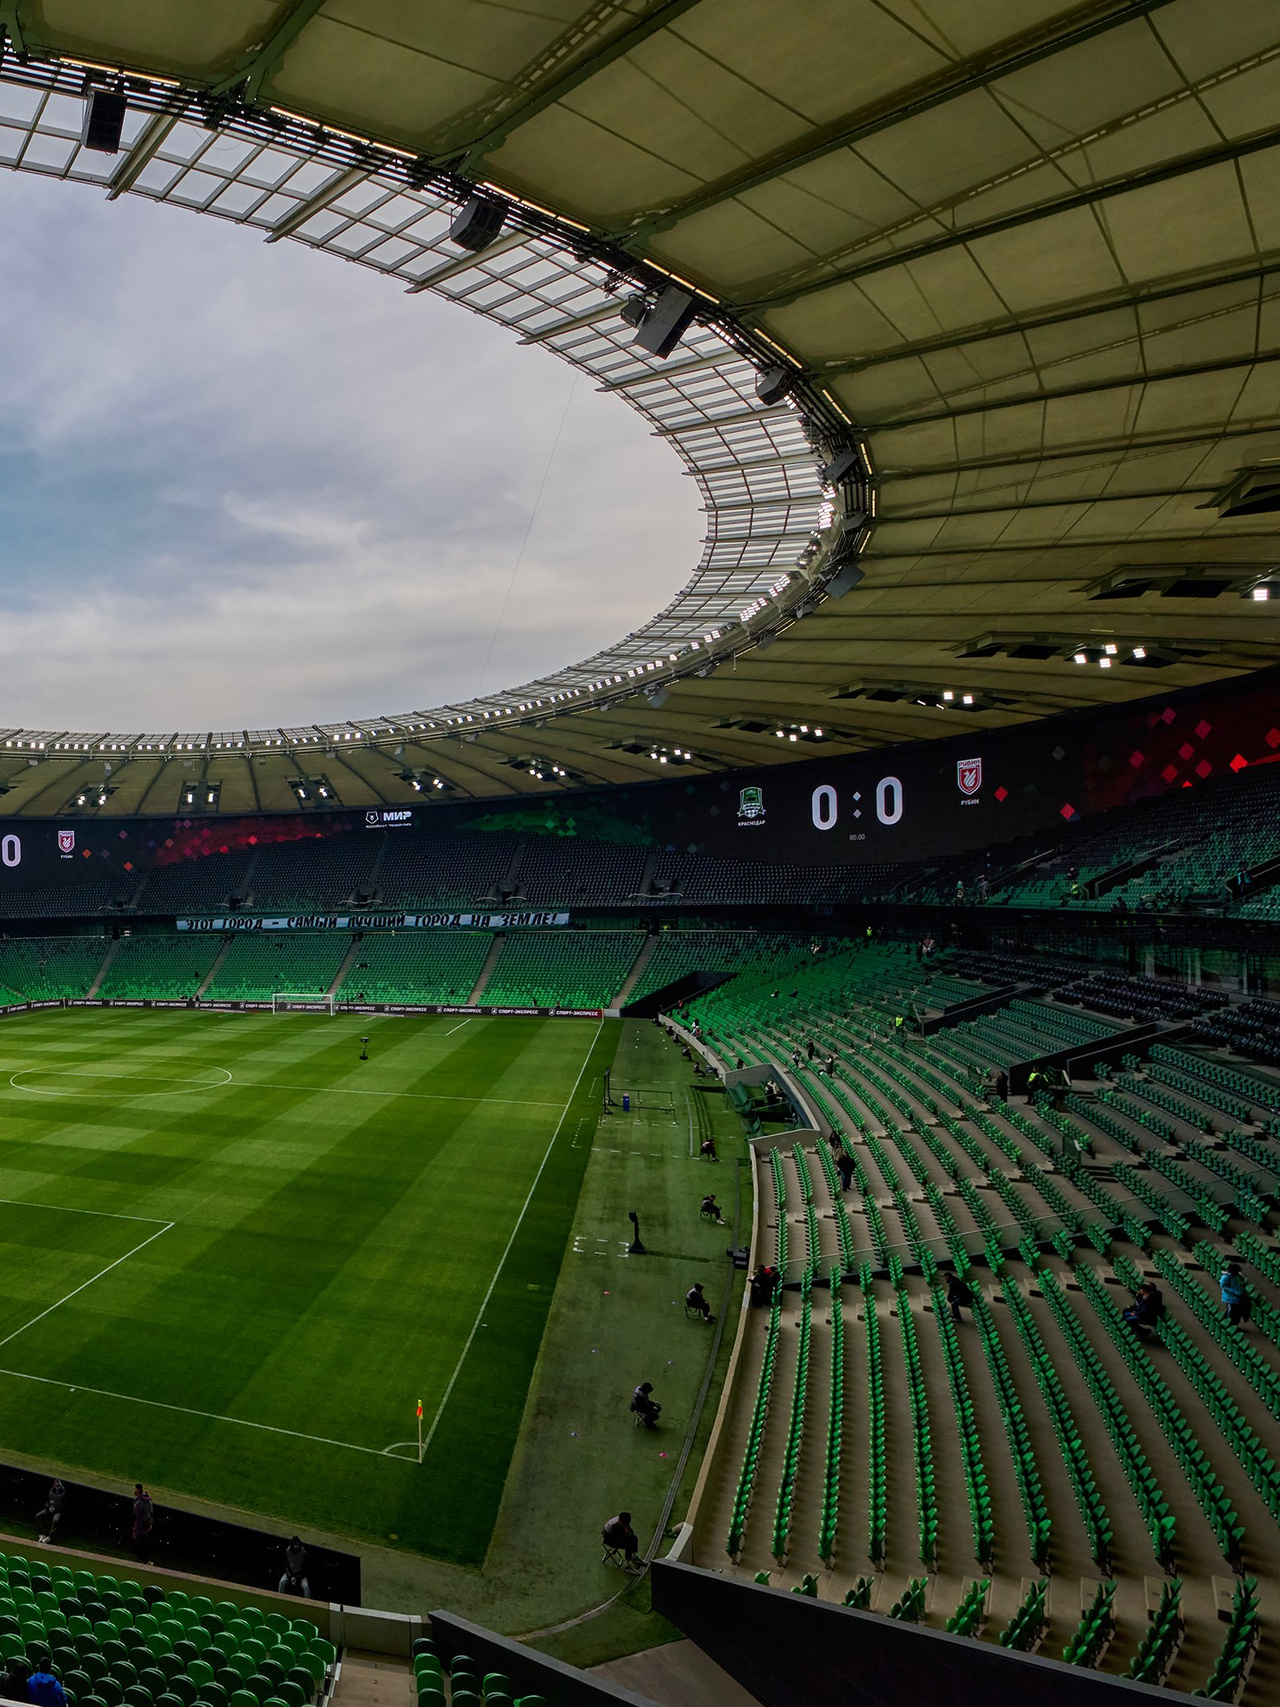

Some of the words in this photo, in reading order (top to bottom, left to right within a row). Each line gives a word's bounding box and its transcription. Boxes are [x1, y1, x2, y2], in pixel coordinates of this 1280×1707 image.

[811, 784, 838, 831] 0
[876, 776, 904, 825] 0
[383, 811, 412, 821] МИР
[1, 834, 22, 868] 0
[186, 918, 214, 930] ЭТОТ
[222, 917, 264, 931] ГОРОД
[287, 913, 338, 928] САМЫЙ
[347, 911, 405, 928] ЛУЧШИЙ
[414, 913, 461, 929] ГОРОД
[470, 914, 490, 928] НА
[500, 912, 558, 927] ЗЕМЛЕ!
[556, 1009, 598, 1017] СПОРТ-ЭКСПРЕСС
